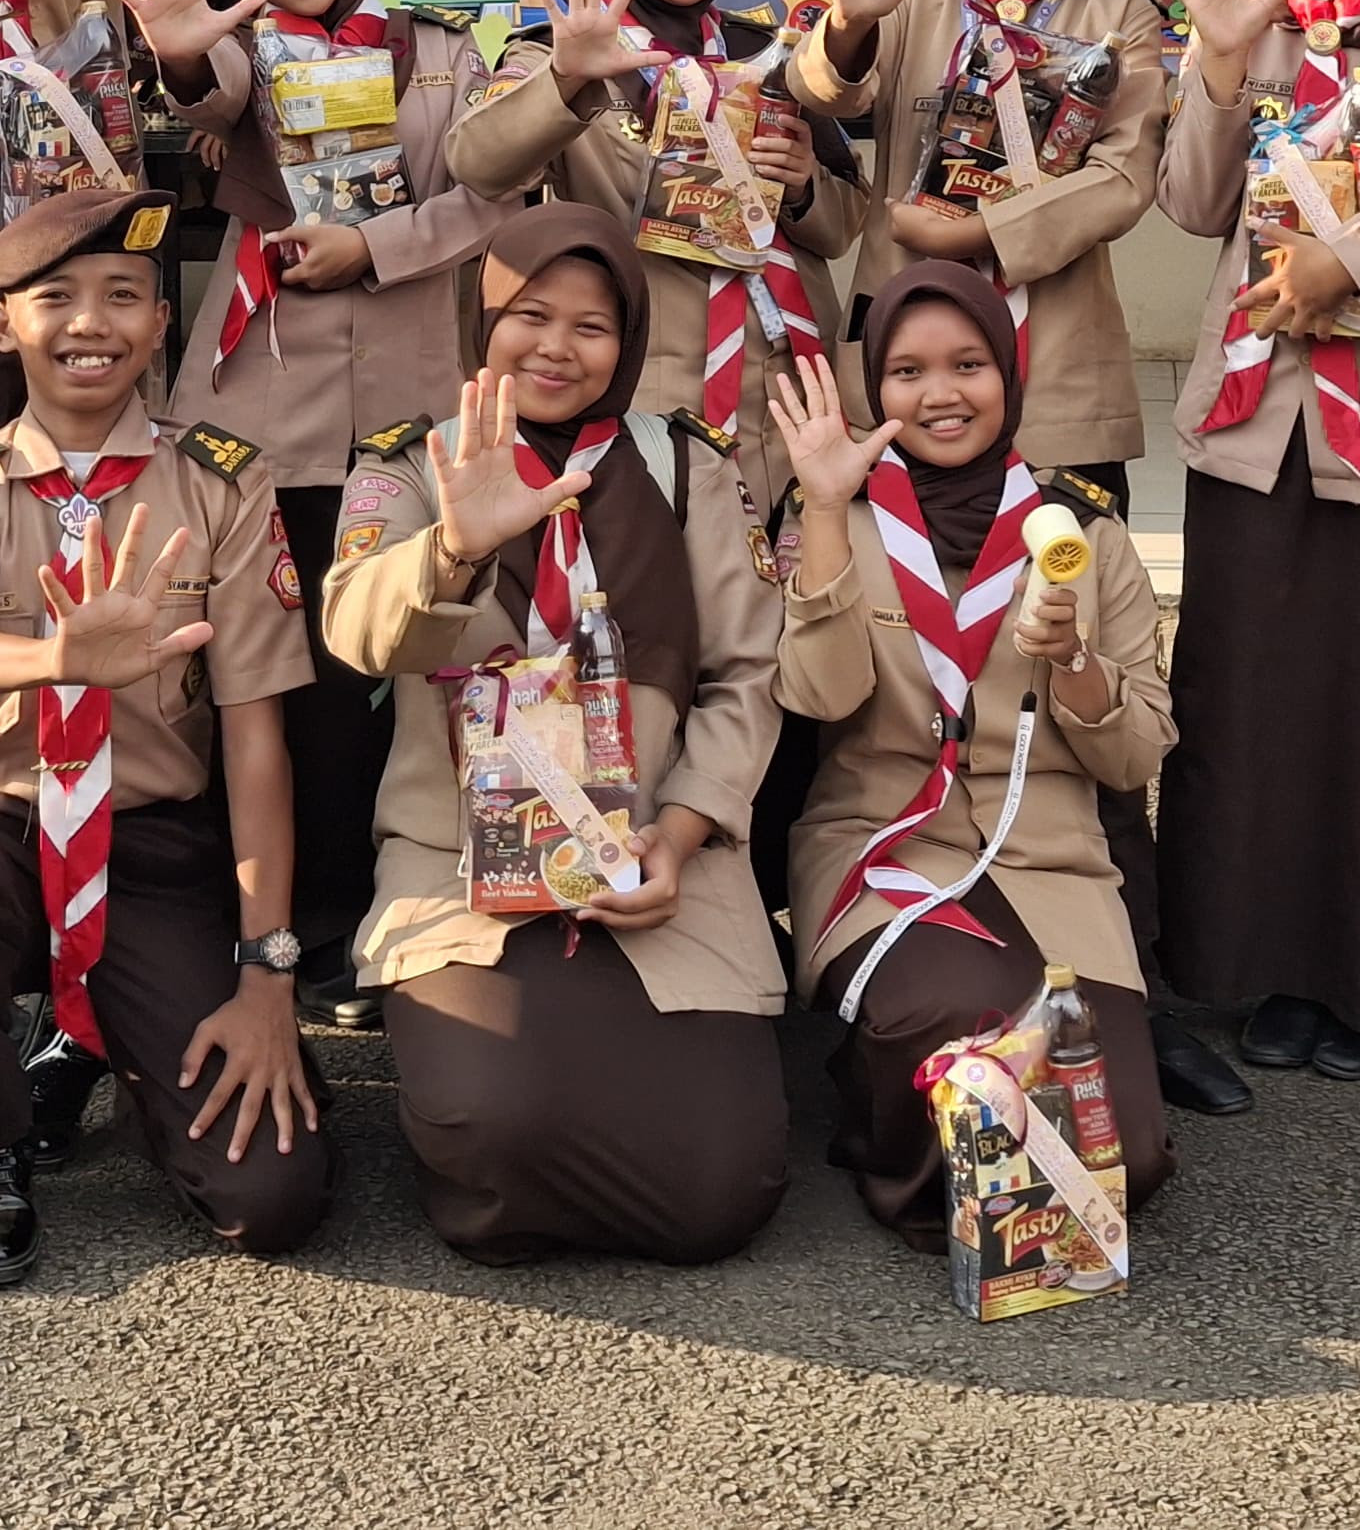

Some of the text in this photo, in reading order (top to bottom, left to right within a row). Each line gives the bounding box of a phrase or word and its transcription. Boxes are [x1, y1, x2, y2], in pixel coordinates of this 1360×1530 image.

[955, 97, 996, 117] BLACK
[941, 158, 1006, 196] Tasty
[662, 176, 726, 218] Tasty
[512, 794, 561, 849] Tas
[482, 869, 537, 891] やきにく
[977, 1133, 1014, 1158] BLAC
[991, 1201, 1066, 1268] Tasty
